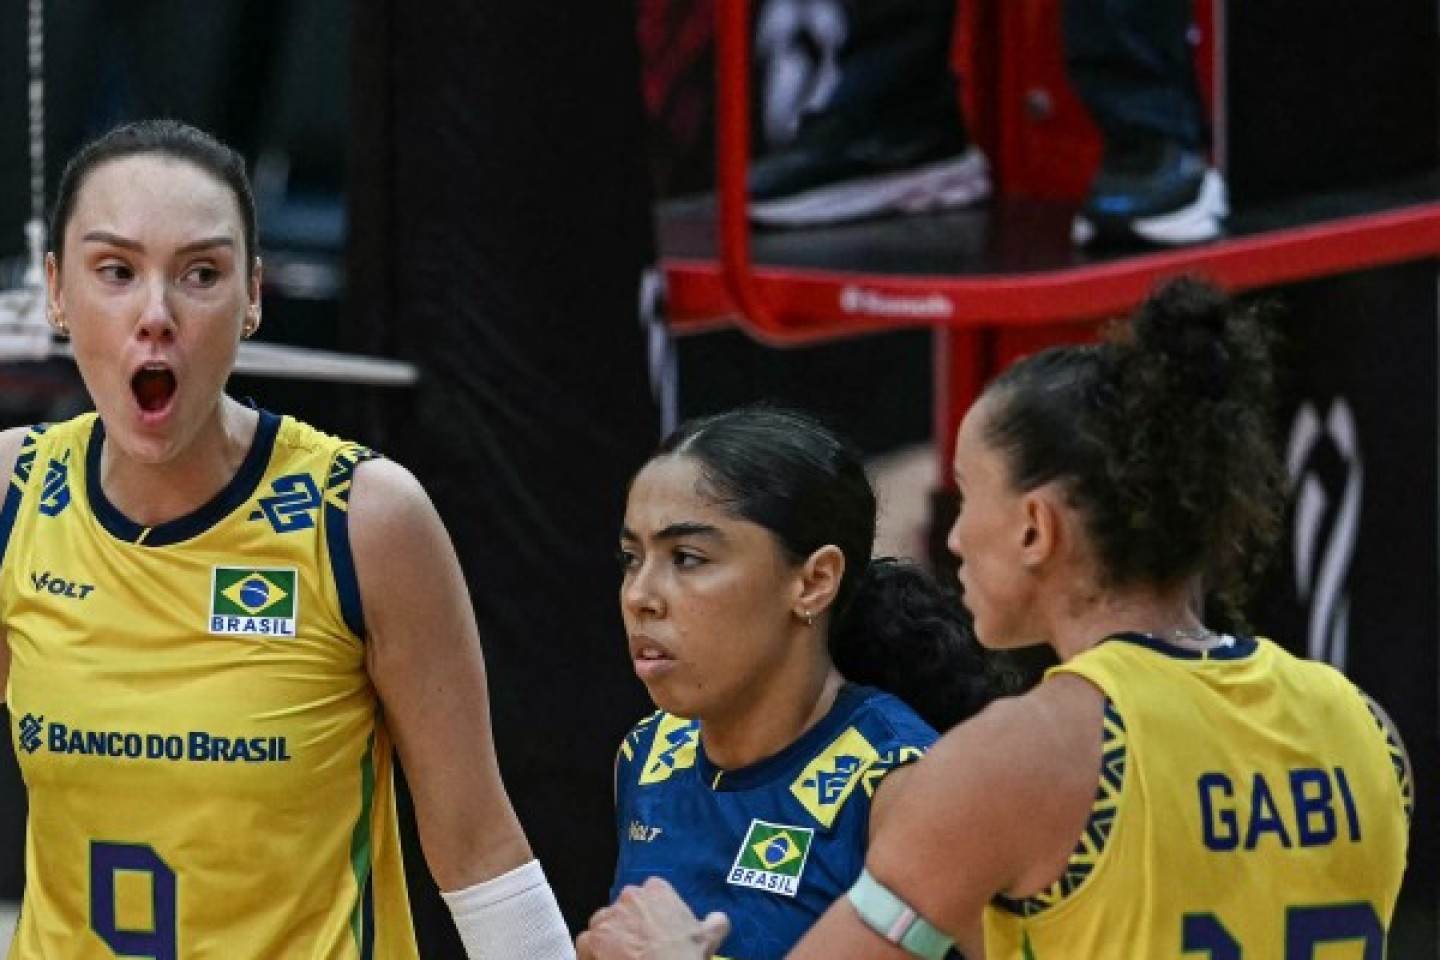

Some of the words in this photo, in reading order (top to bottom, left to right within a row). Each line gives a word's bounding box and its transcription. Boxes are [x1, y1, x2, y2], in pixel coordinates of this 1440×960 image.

[31, 570, 94, 600] VOLT
[211, 616, 293, 635] BRASIL
[48, 722, 142, 758] BANCO
[146, 734, 184, 760] DO
[187, 731, 292, 762] BRASIL
[1197, 767, 1361, 851] GABI
[730, 868, 798, 895] BRASIL
